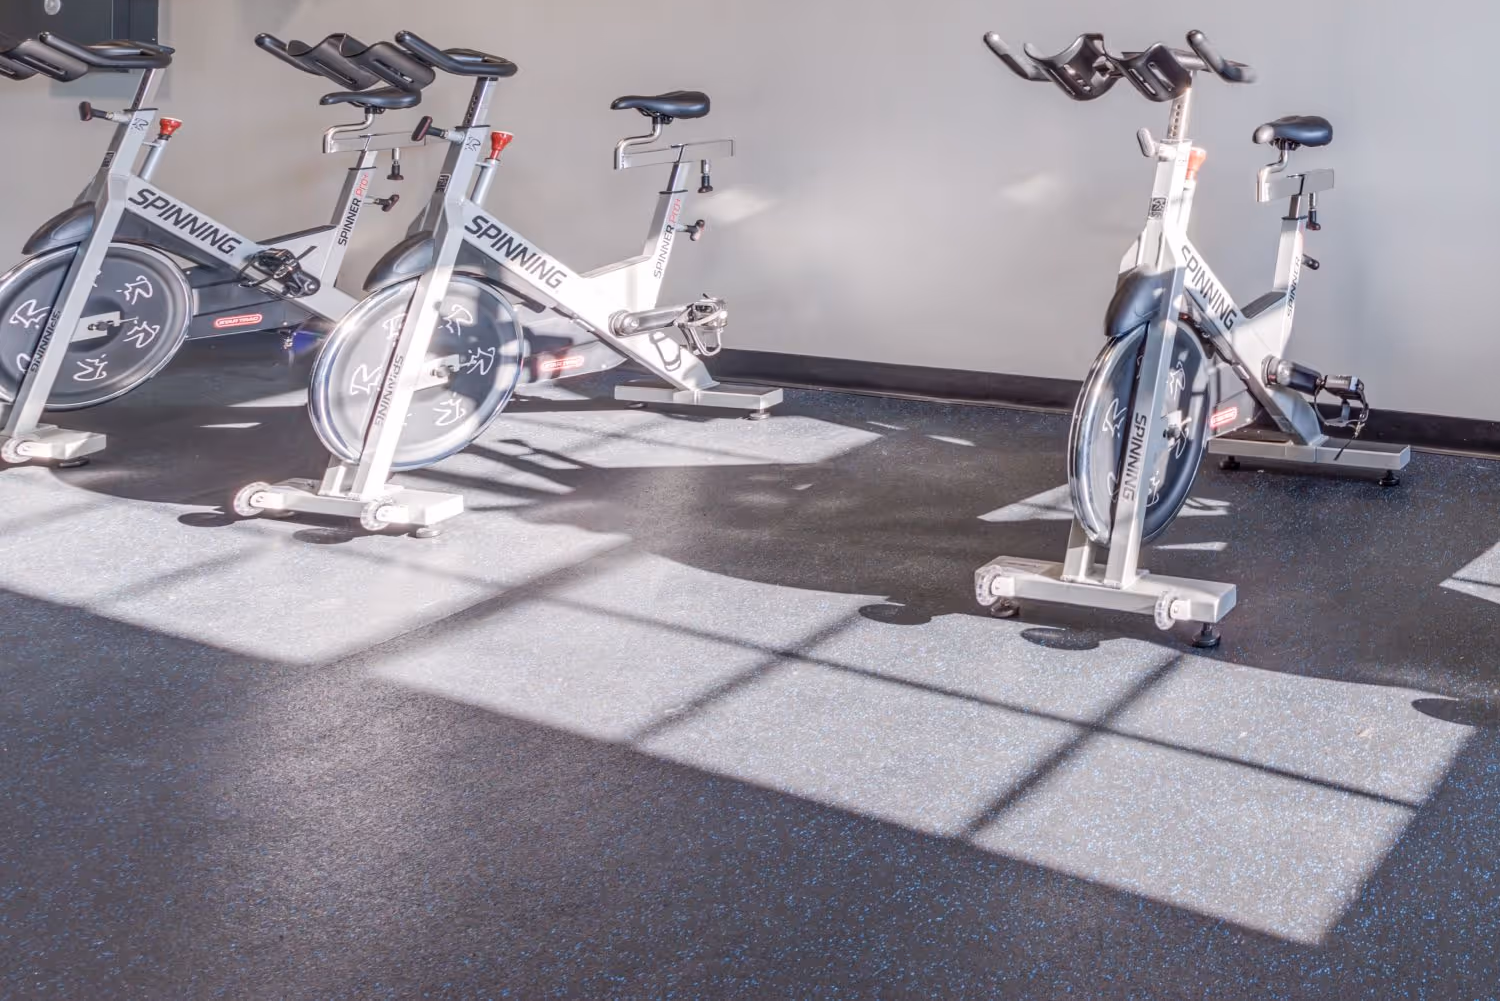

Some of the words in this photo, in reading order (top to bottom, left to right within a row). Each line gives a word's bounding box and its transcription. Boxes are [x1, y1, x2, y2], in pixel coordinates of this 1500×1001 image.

[128, 188, 243, 255] SPINNING
[338, 197, 362, 246] SPINNER
[355, 172, 369, 197] Pro+
[464, 215, 567, 290] SPINNING
[653, 225, 674, 280] SPINNER
[1181, 245, 1237, 331] SPINNING
[1287, 256, 1301, 319] SPINNER
[30, 310, 61, 374] SPINNING
[375, 354, 404, 427] SPINNING
[1122, 412, 1147, 502] SPINNING
